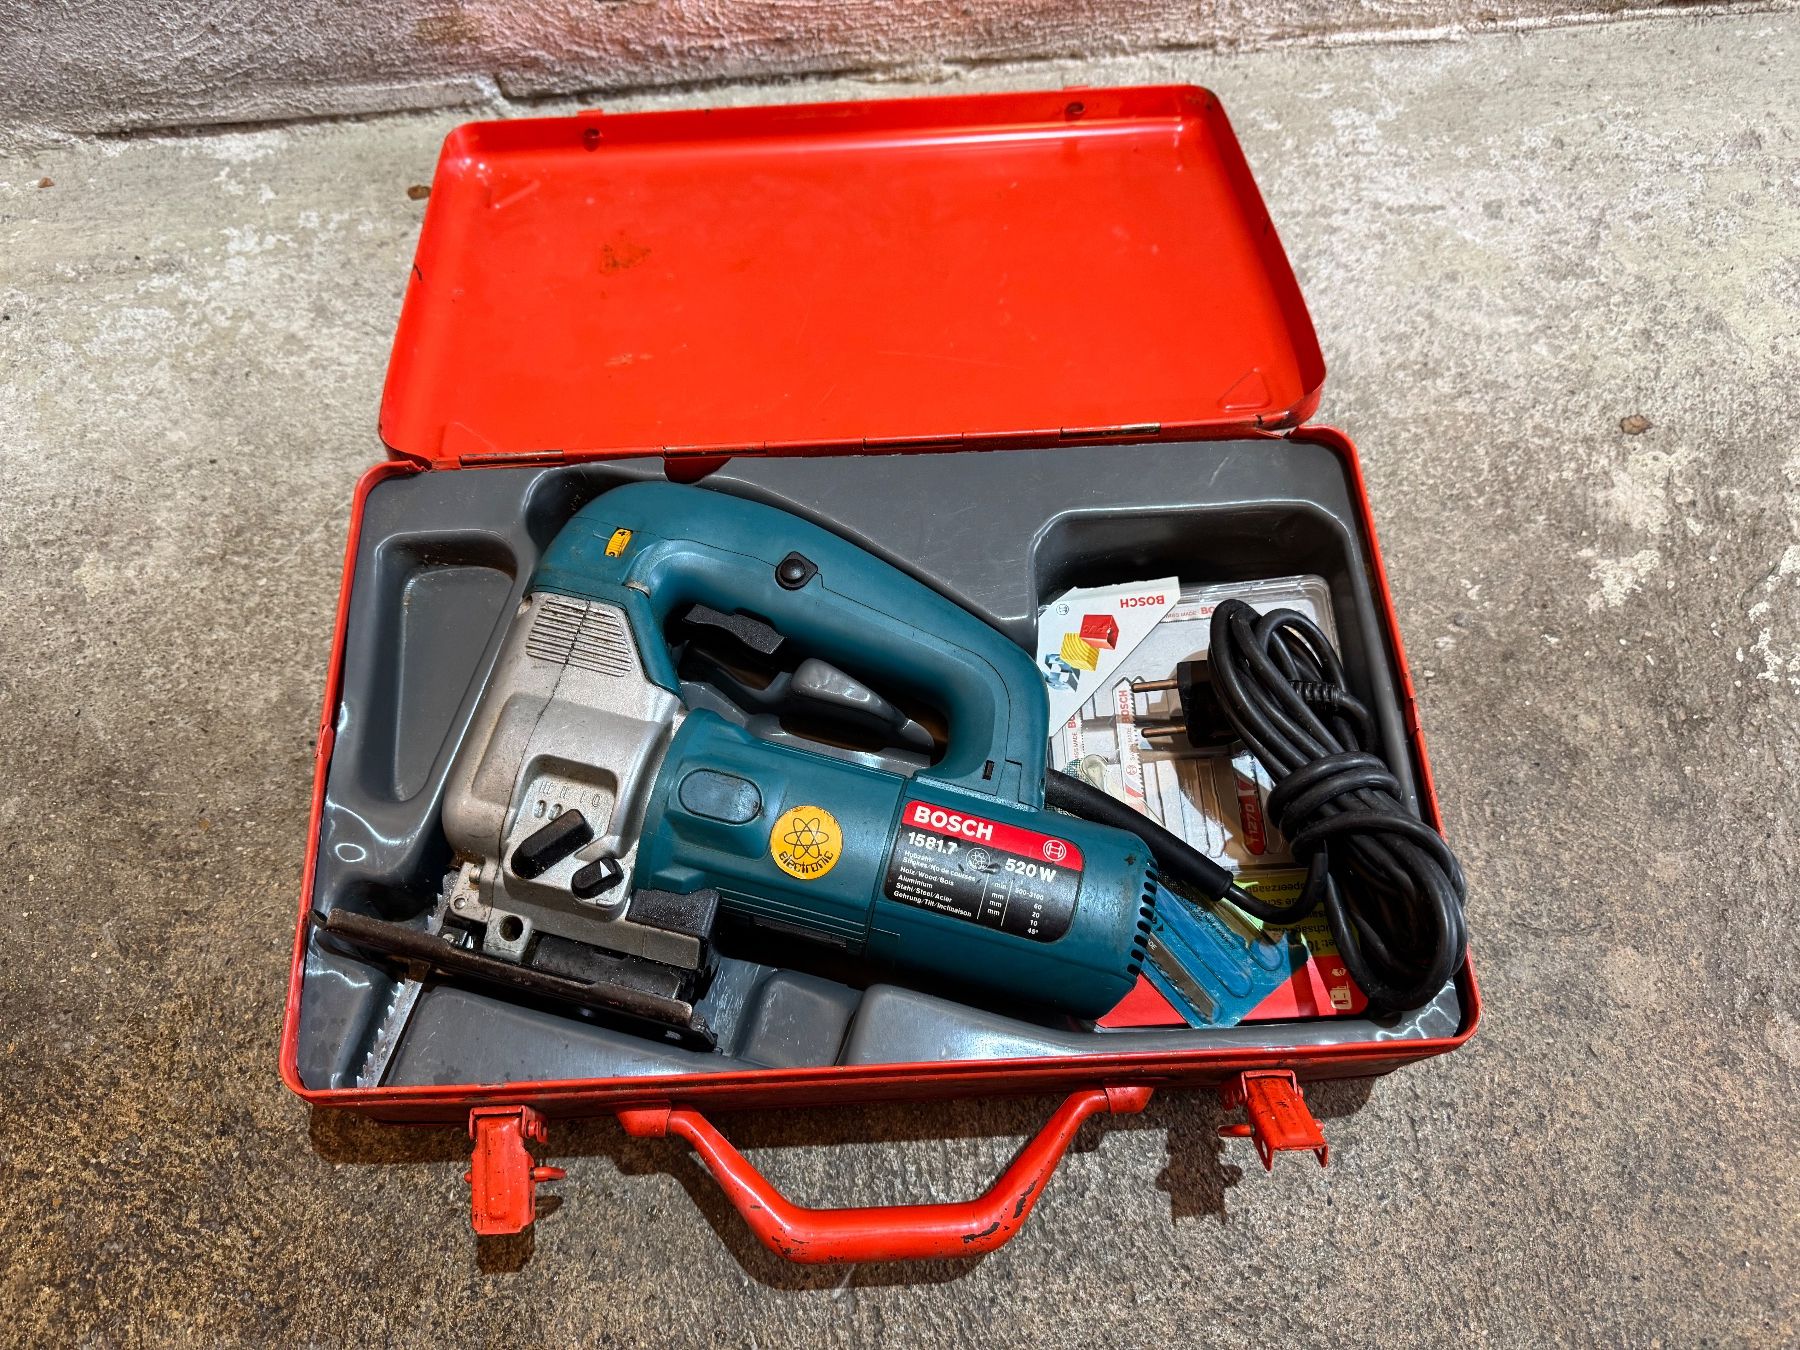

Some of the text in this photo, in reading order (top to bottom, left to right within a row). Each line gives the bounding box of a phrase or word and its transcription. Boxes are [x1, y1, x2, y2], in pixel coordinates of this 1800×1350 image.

[1120, 594, 1165, 609] BOSCH
[1118, 689, 1130, 724] BOSCH
[913, 805, 994, 841] BOSCH
[907, 832, 958, 856] 1581.7
[778, 850, 834, 874] electronic
[1004, 858, 1057, 883] 520 W
[898, 874, 933, 889] Aluminium
[991, 892, 1004, 900] mm
[987, 908, 1000, 916] mm
[989, 900, 1040, 919] mm 20
